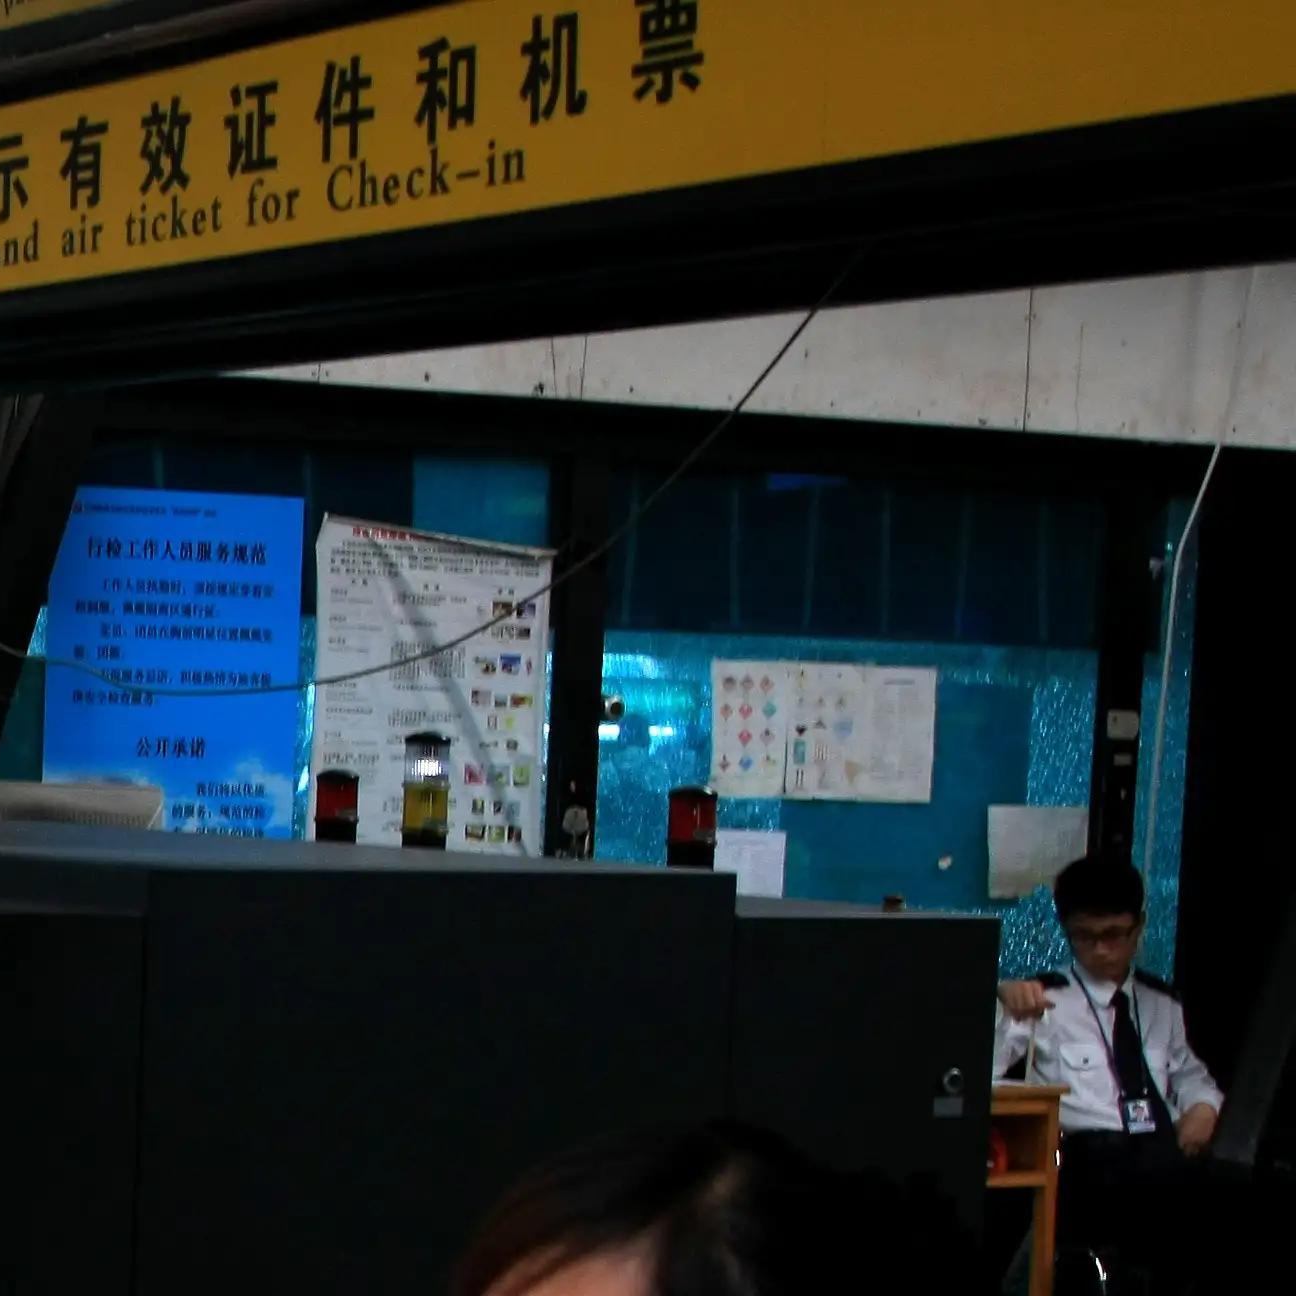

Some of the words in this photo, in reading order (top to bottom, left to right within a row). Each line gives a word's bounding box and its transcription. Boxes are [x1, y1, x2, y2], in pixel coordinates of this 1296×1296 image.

[61, 213, 104, 257] air
[125, 193, 223, 247] ticket
[246, 177, 301, 227] for
[326, 138, 527, 212] Check-in
